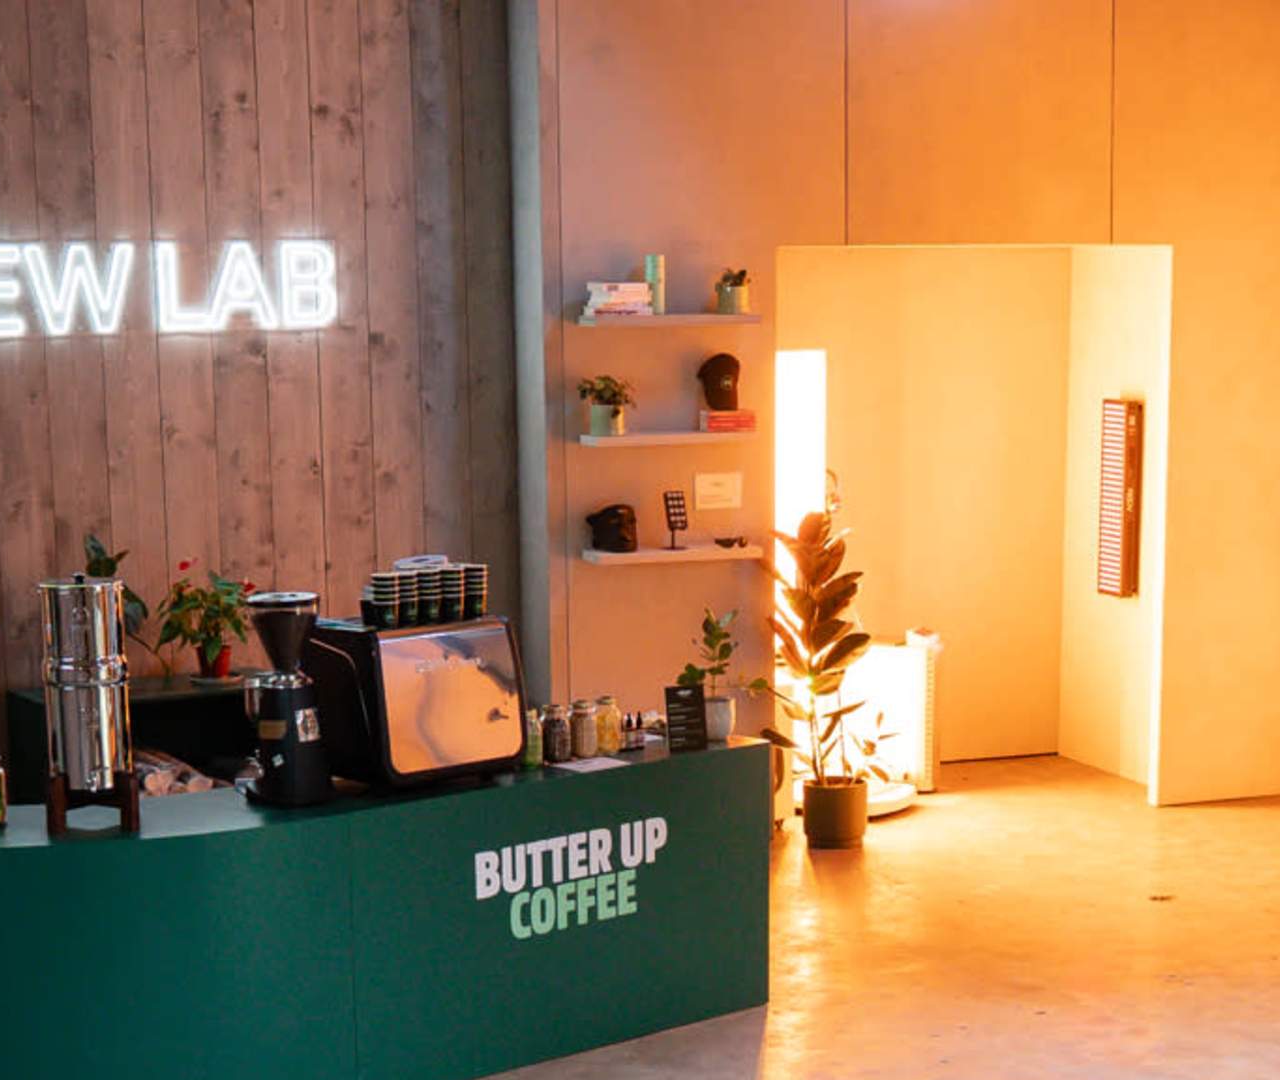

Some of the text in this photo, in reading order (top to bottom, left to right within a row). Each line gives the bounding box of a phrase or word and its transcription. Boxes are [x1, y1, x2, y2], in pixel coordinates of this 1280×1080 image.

[154, 240, 339, 334] LAB
[475, 817, 668, 901] BUTTER UP
[510, 869, 638, 940] COFFEE
